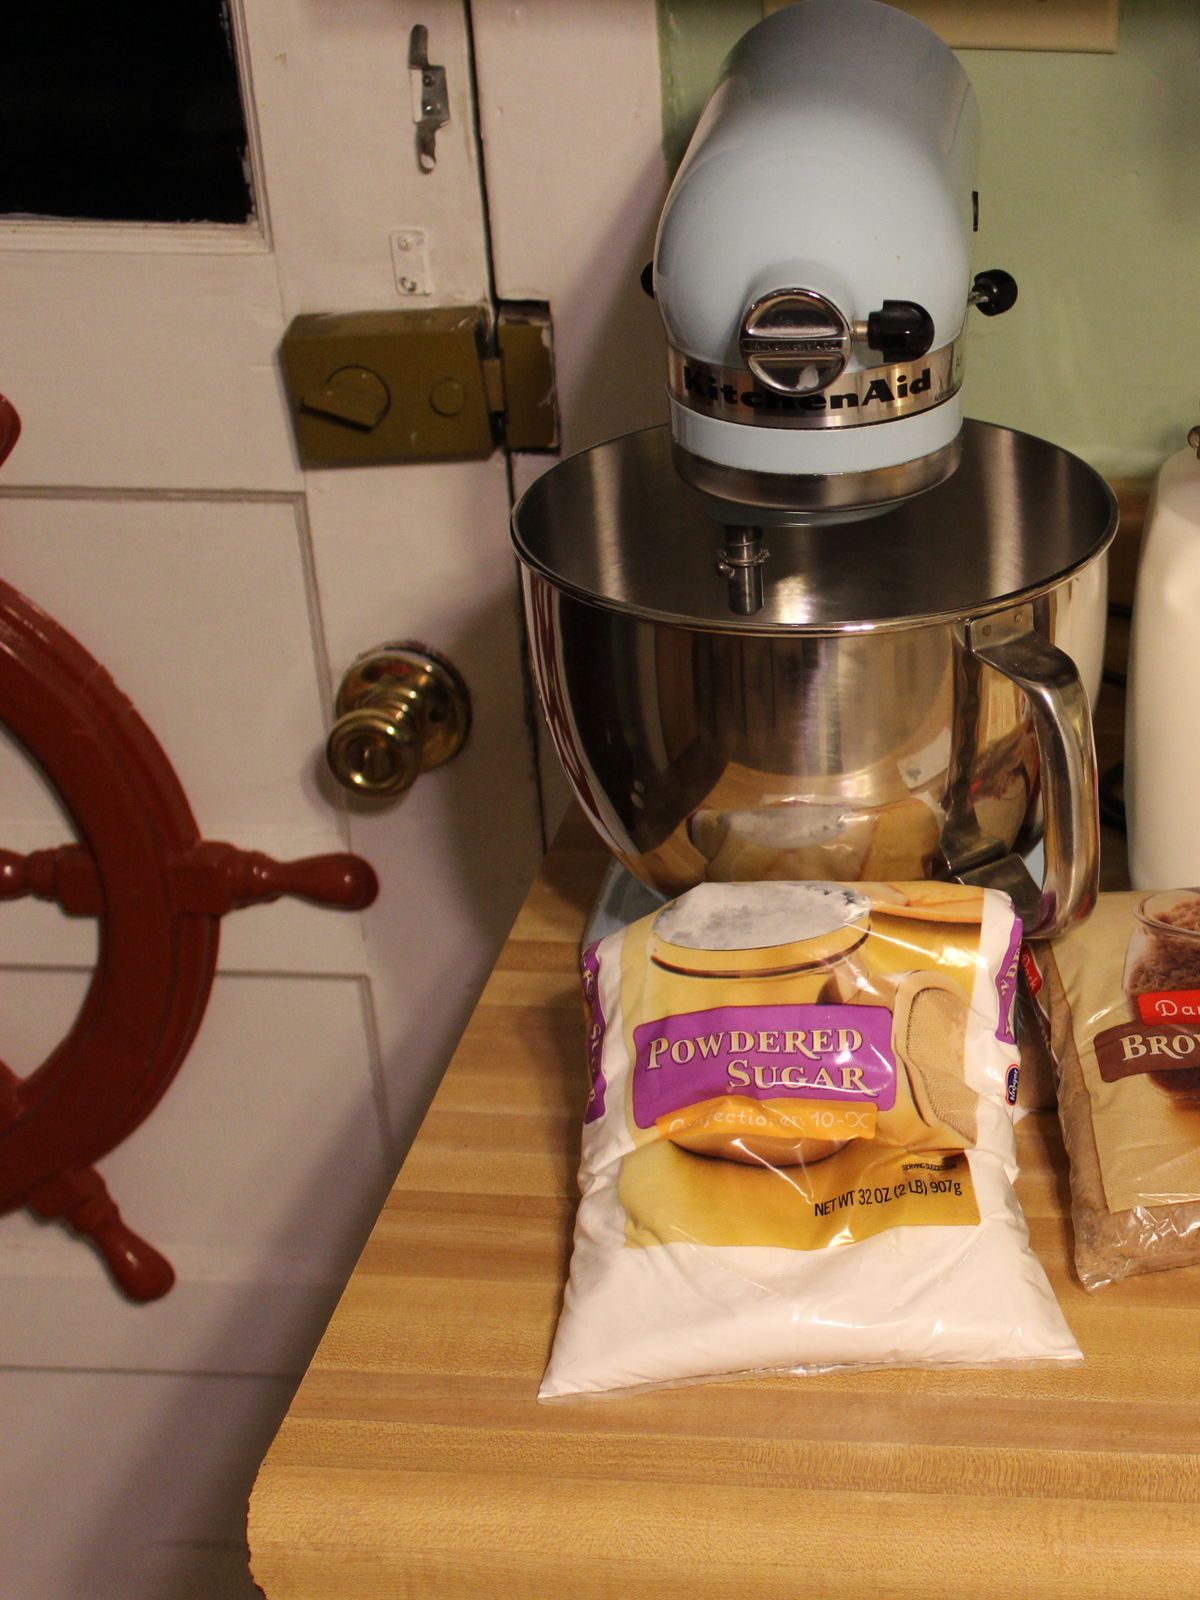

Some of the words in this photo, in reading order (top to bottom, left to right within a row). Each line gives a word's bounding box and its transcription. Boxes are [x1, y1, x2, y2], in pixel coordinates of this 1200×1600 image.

[646, 1028, 863, 1070] POWDERED
[727, 1059, 879, 1096] SUGAR
[814, 1198, 837, 1217] NET
[838, 1190, 855, 1208] WT
[858, 1189, 871, 1205] 32
[874, 1187, 892, 1204] OZ
[894, 1186, 906, 1200] (2
[909, 1179, 928, 1195] LB)
[929, 1179, 962, 1196] 907g
